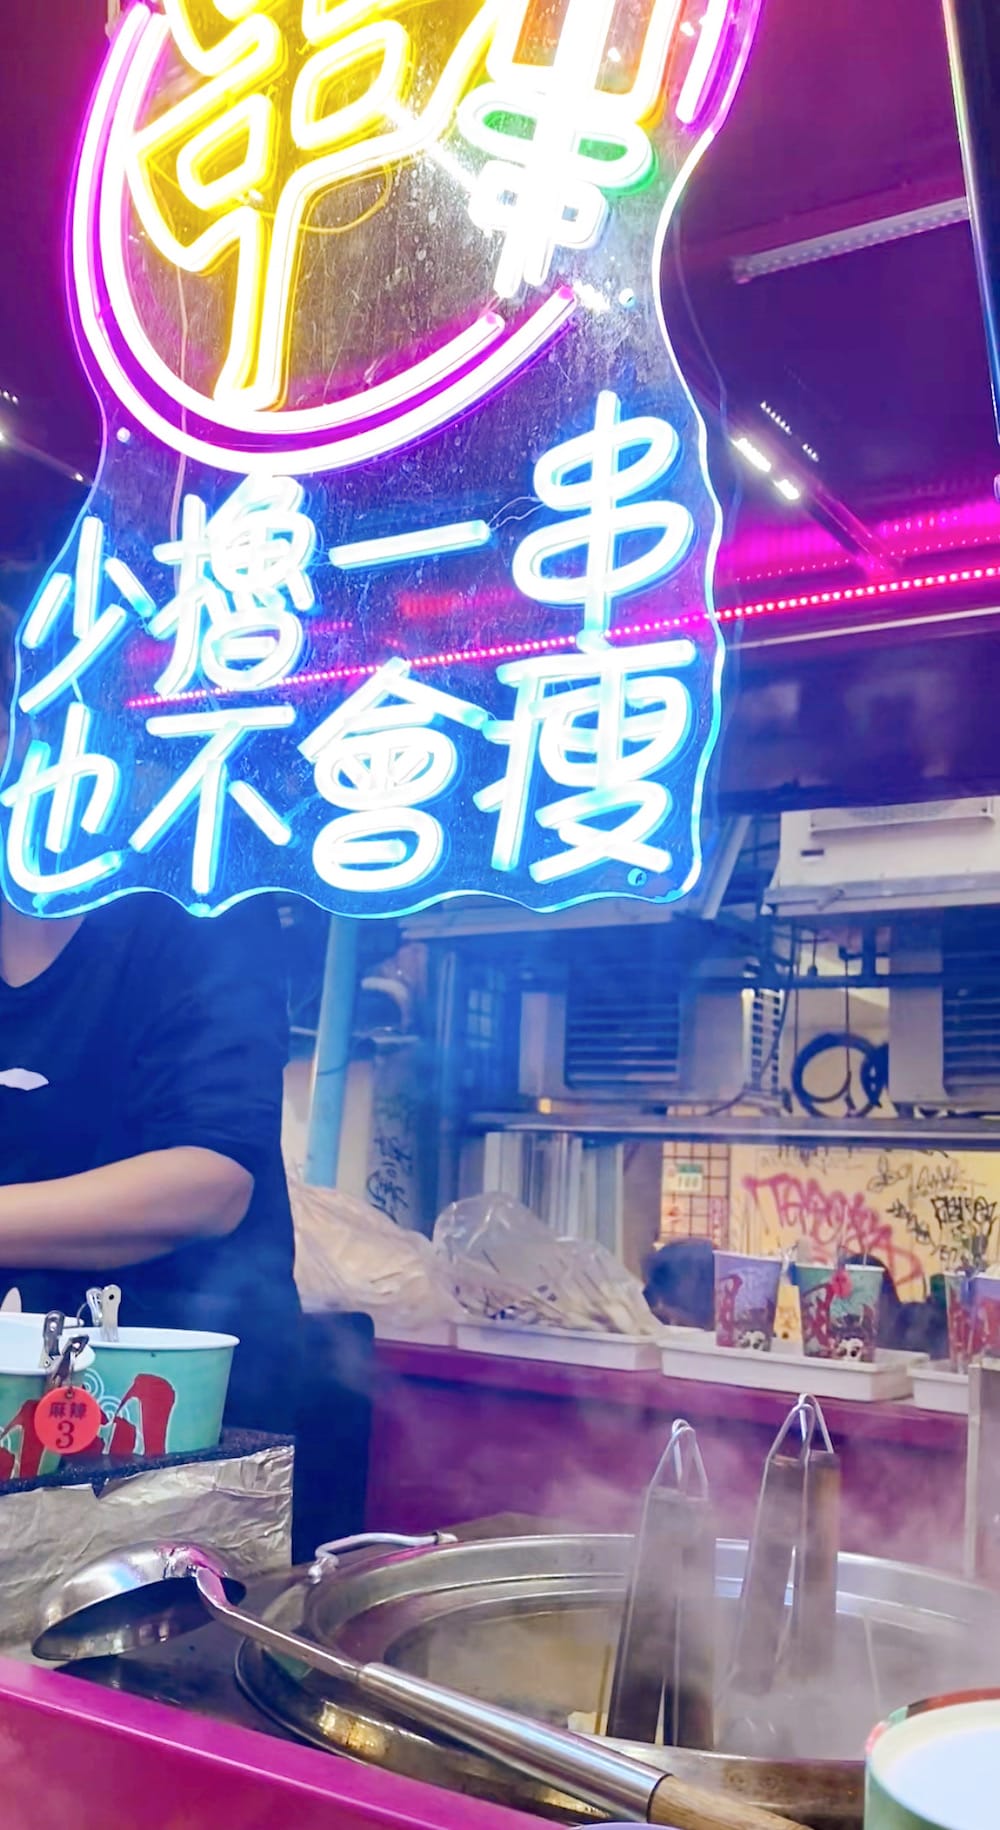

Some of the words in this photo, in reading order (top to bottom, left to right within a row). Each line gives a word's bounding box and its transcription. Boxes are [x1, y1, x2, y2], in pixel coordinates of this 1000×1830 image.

[1, 638, 697, 896] 也不會瘦
[49, 1402, 87, 1419] 麻辣
[56, 1421, 74, 1448] 3
